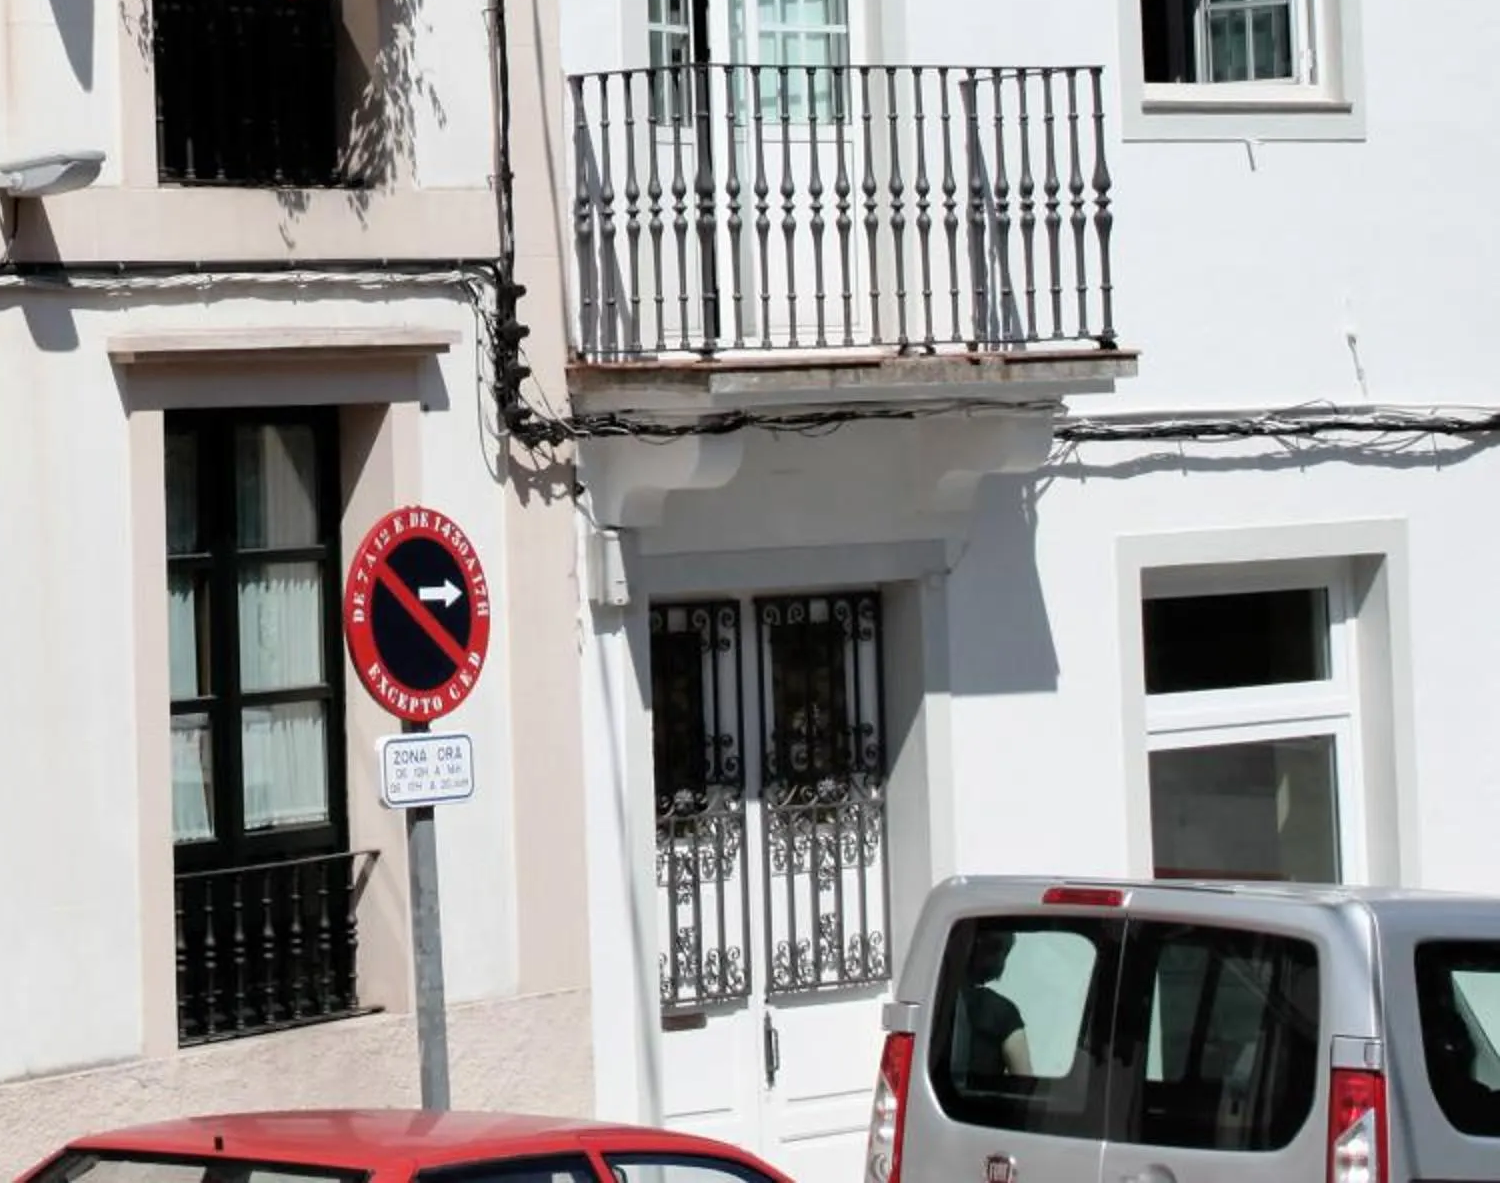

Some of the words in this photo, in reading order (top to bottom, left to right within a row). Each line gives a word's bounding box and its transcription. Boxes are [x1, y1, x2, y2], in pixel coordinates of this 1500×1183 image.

[409, 512, 429, 528] DE
[368, 662, 443, 715] EXCEPTO
[393, 748, 427, 766] ZONA
